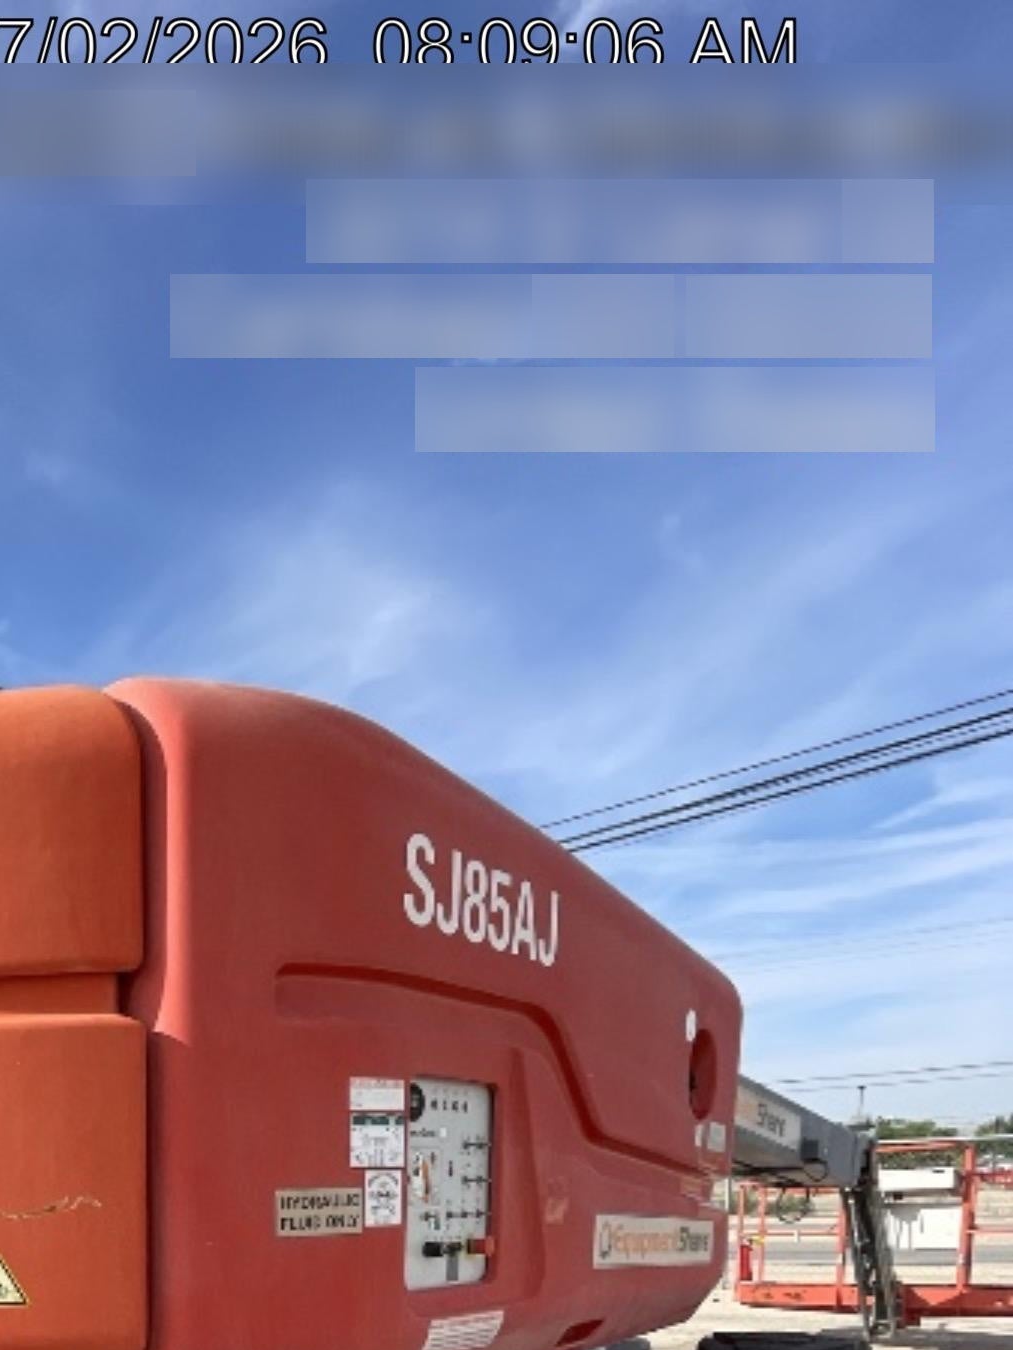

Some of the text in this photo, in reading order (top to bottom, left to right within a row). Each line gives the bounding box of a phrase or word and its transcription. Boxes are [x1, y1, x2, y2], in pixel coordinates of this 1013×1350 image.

[403, 833, 559, 967] SJ85AJ
[280, 1193, 359, 1210] HYDRAULIC
[280, 1214, 360, 1231] FLUID ONLY
